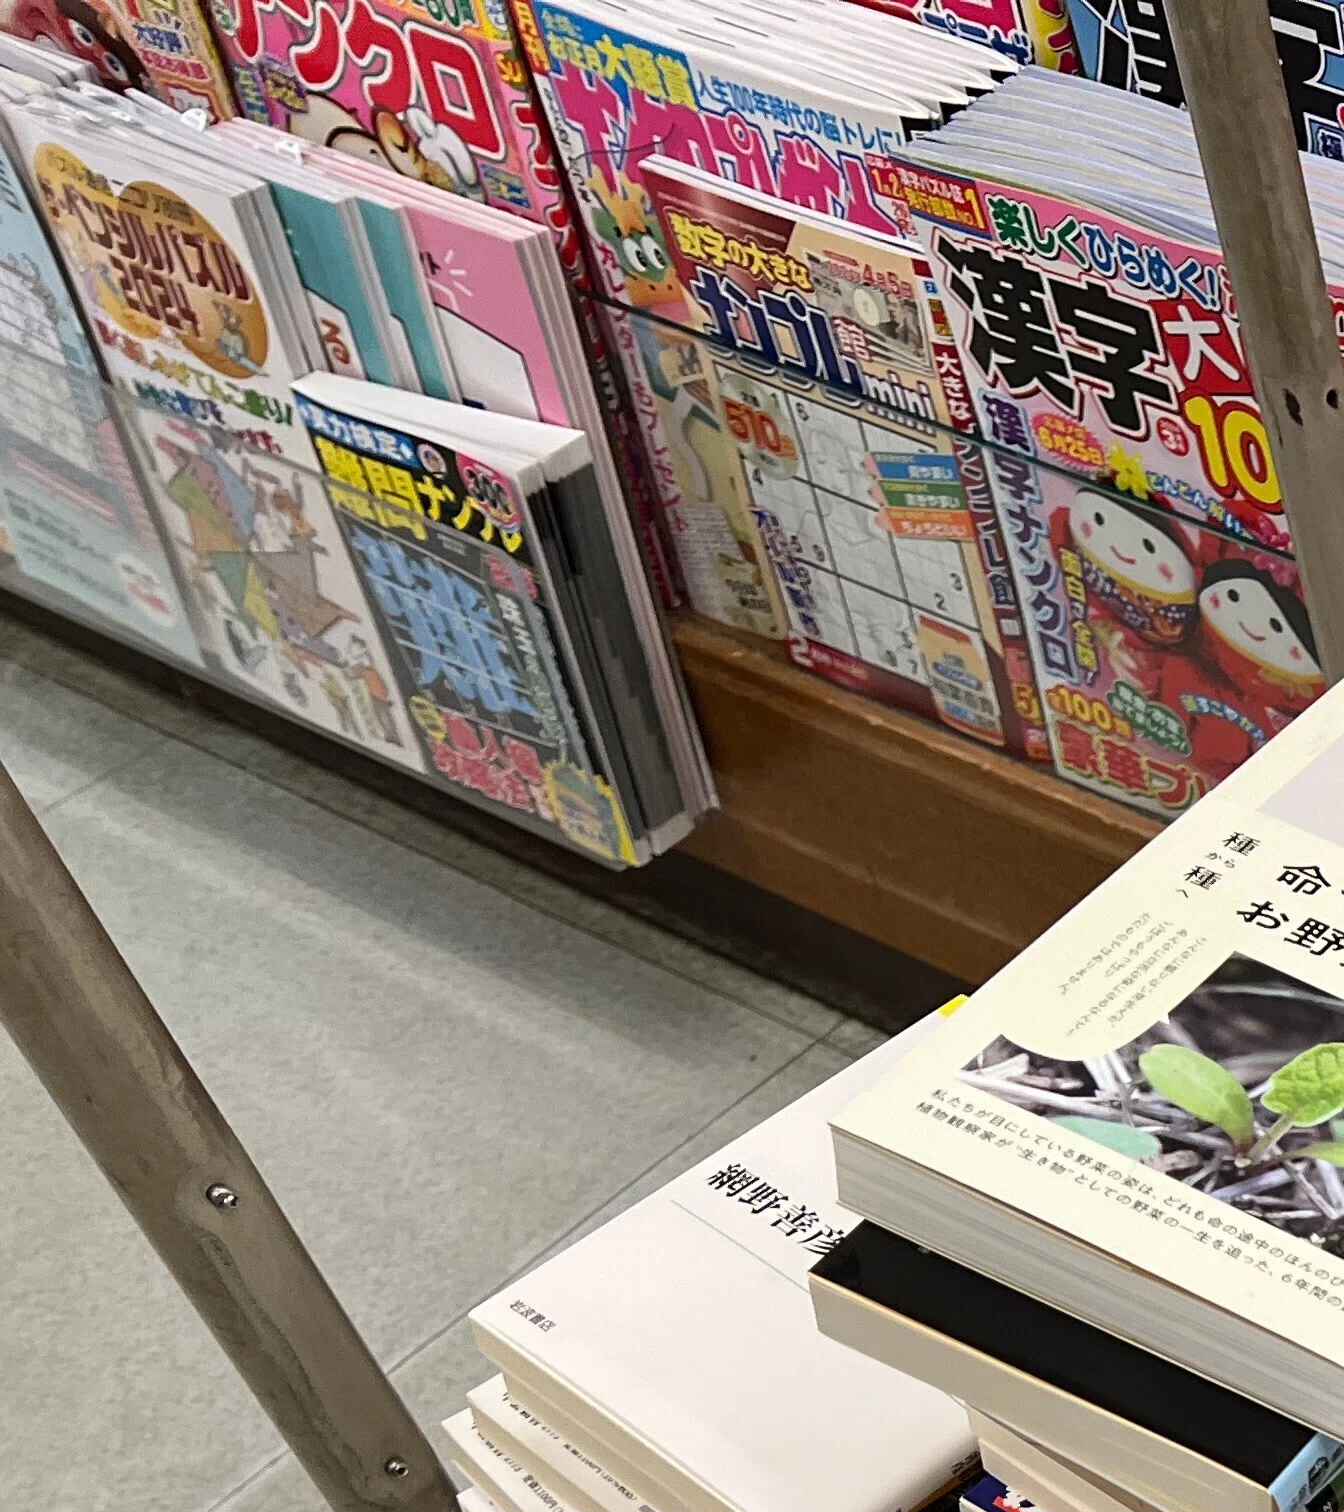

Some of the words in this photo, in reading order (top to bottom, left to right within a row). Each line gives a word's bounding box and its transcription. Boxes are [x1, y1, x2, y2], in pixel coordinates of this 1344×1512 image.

[667, 212, 814, 292] 数字の大きな
[987, 195, 1221, 311] 楽しくひらめく!
[936, 233, 1178, 431] 漢字
